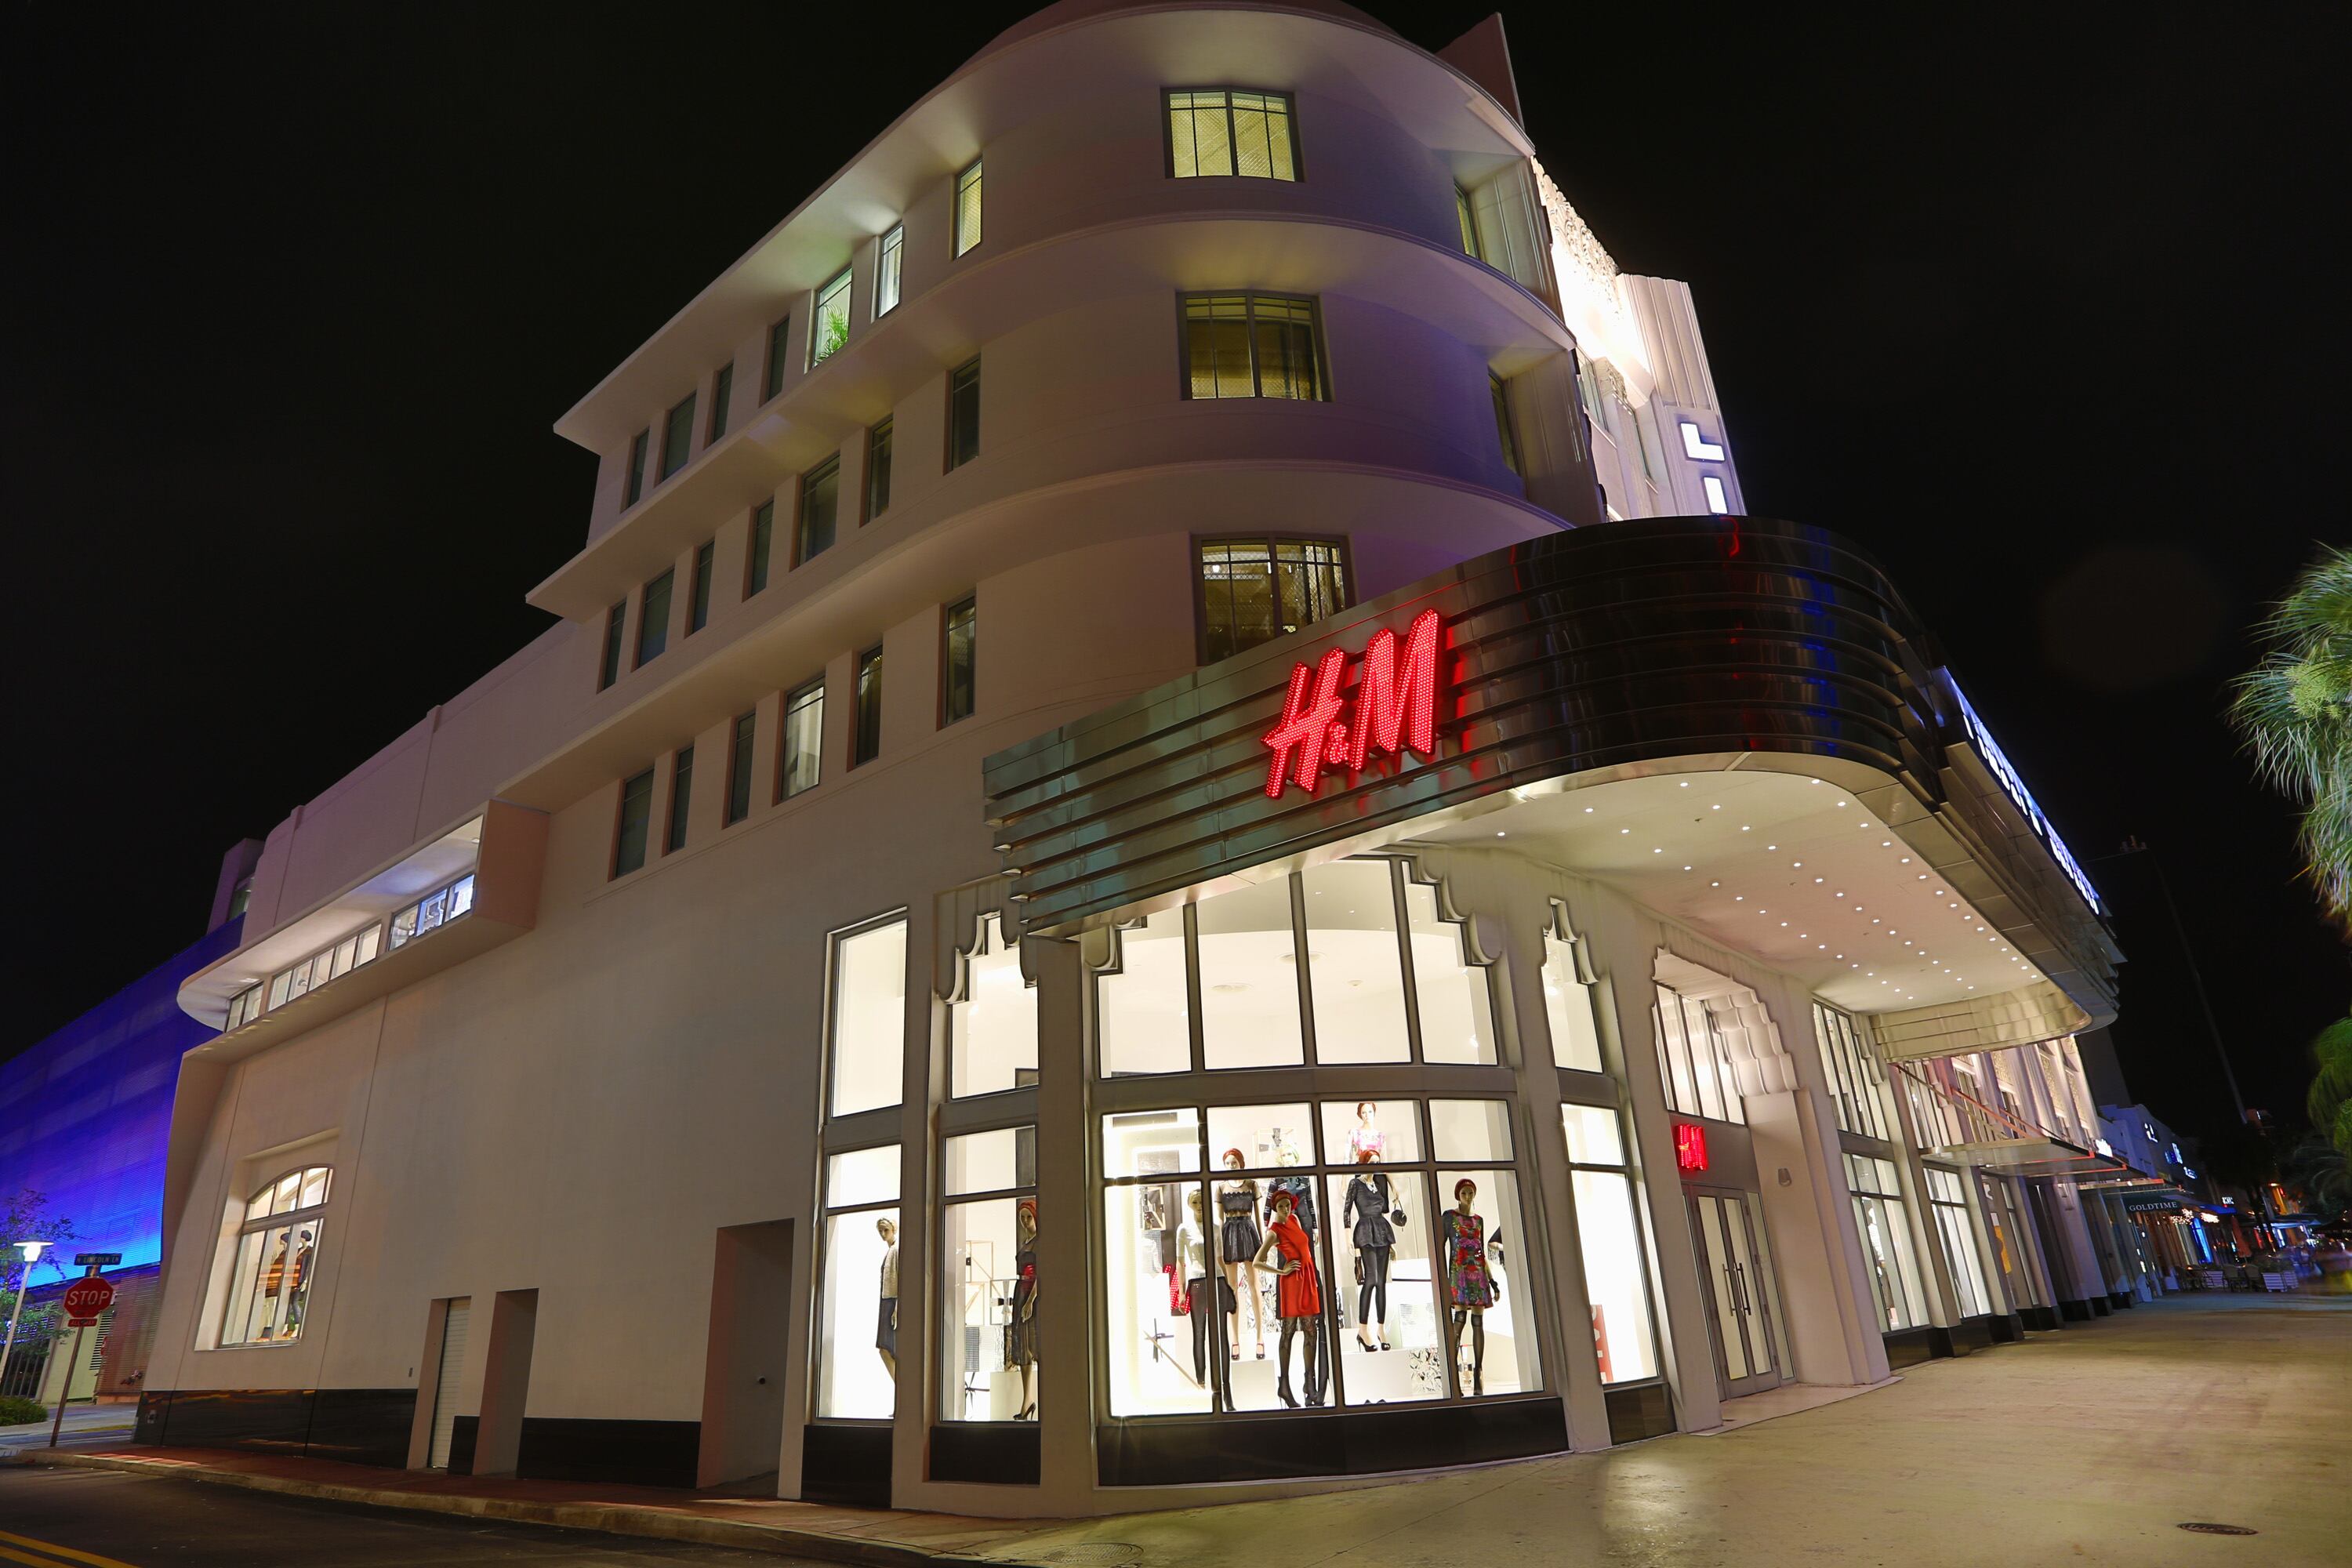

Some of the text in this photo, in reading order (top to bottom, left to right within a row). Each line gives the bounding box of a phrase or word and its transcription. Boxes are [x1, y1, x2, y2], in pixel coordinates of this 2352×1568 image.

[1261, 608, 1441, 800] H&M
[2129, 1201, 2178, 1212] GOLDTIME
[67, 1290, 110, 1305] STOP
